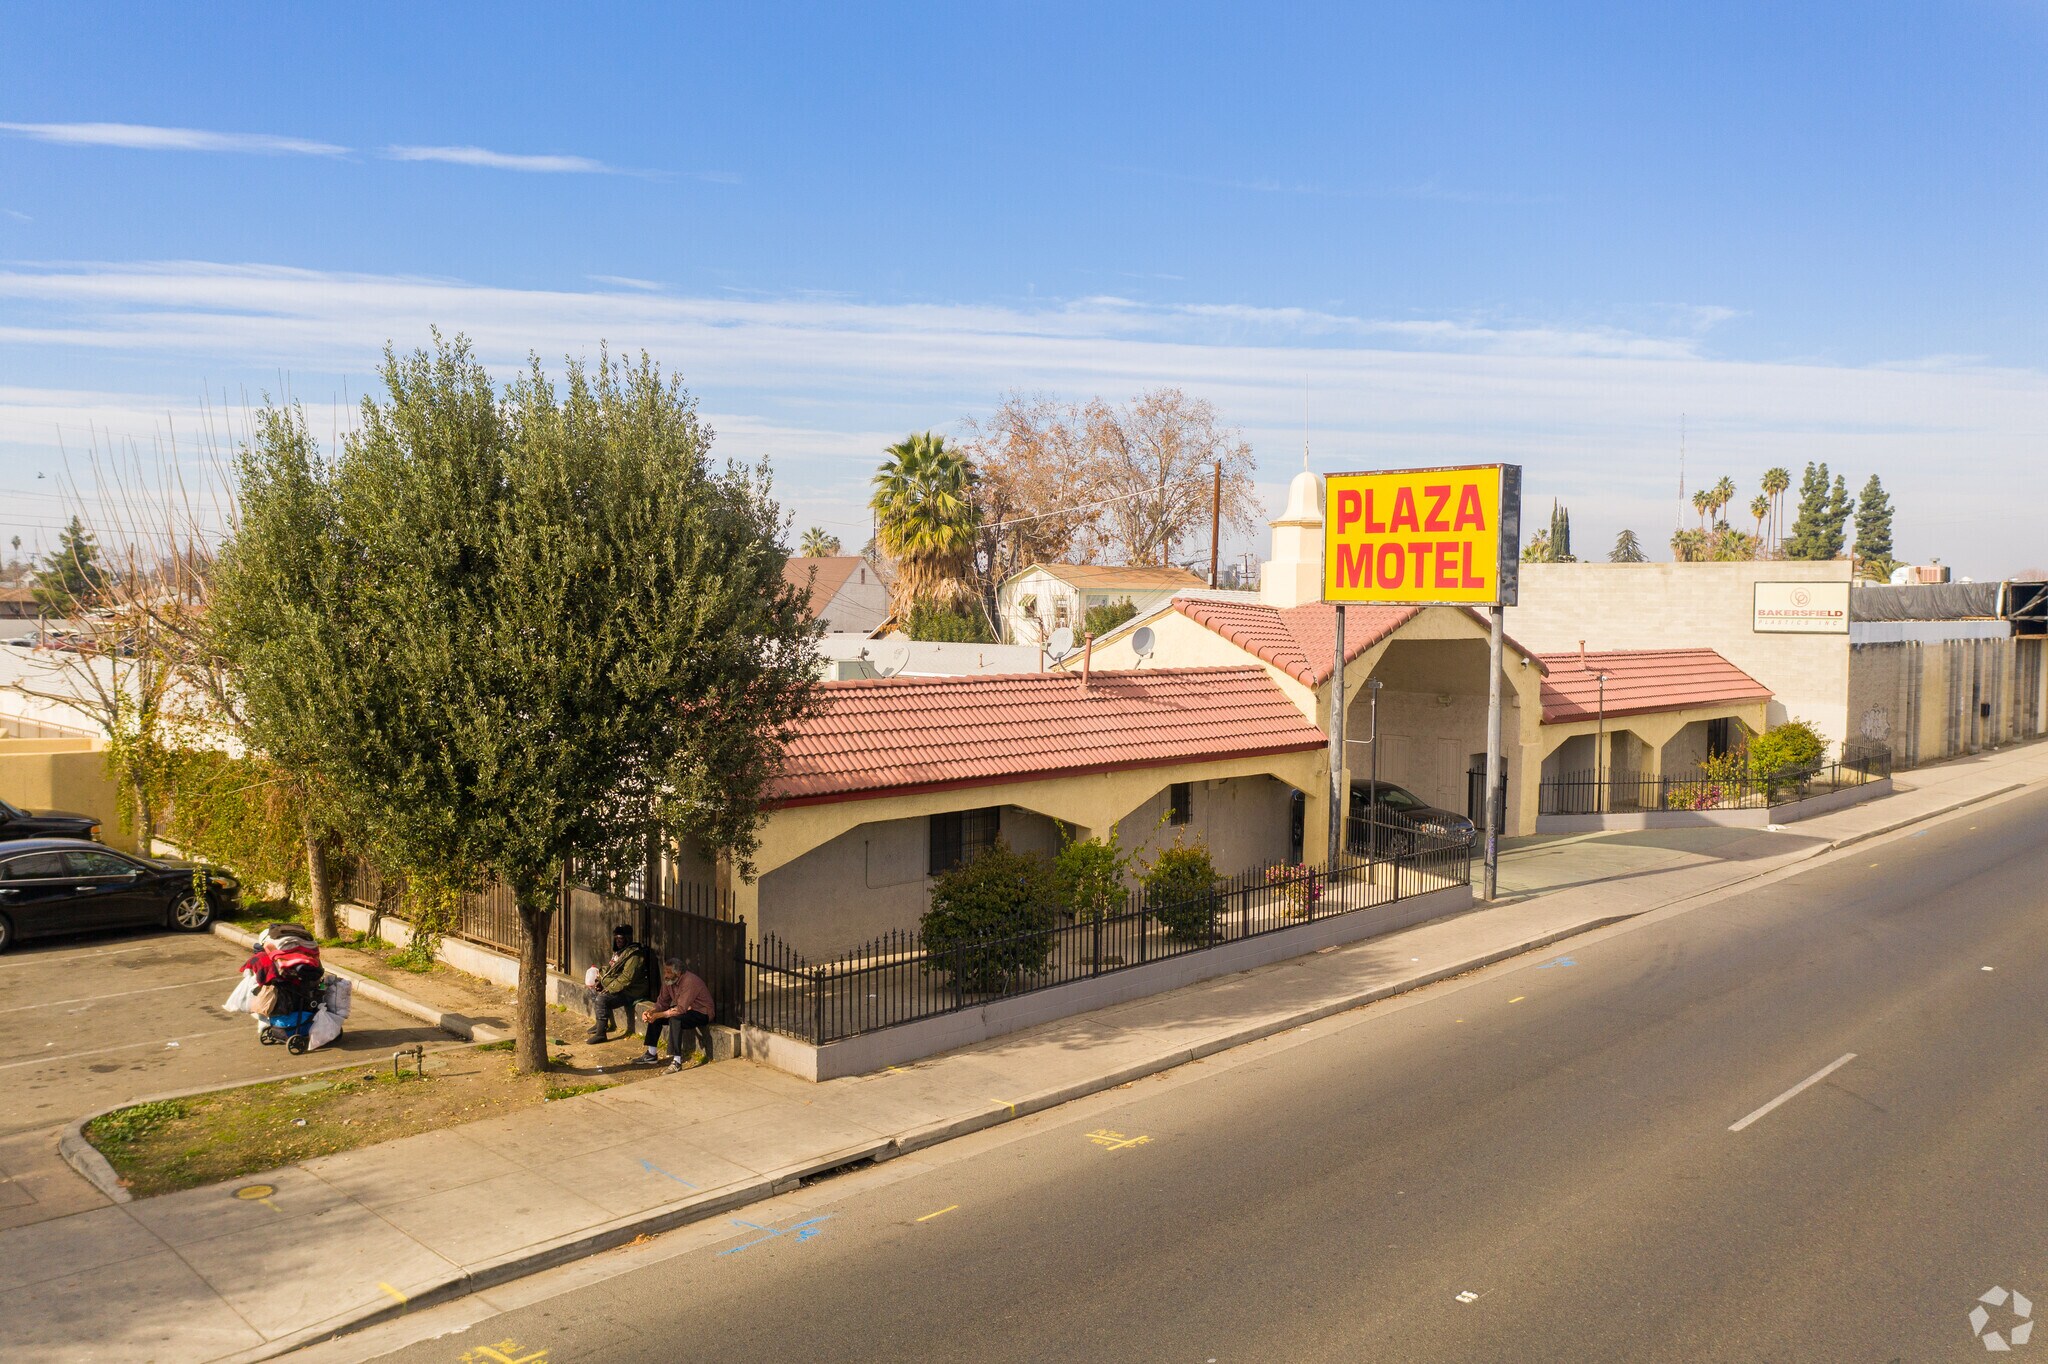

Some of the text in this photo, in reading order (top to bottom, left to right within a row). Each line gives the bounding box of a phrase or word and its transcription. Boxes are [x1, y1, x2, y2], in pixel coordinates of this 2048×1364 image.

[1337, 484, 1486, 534] PLAZA
[1336, 541, 1485, 589] MOTEL
[1758, 609, 1843, 617] BAKERSFIELD
